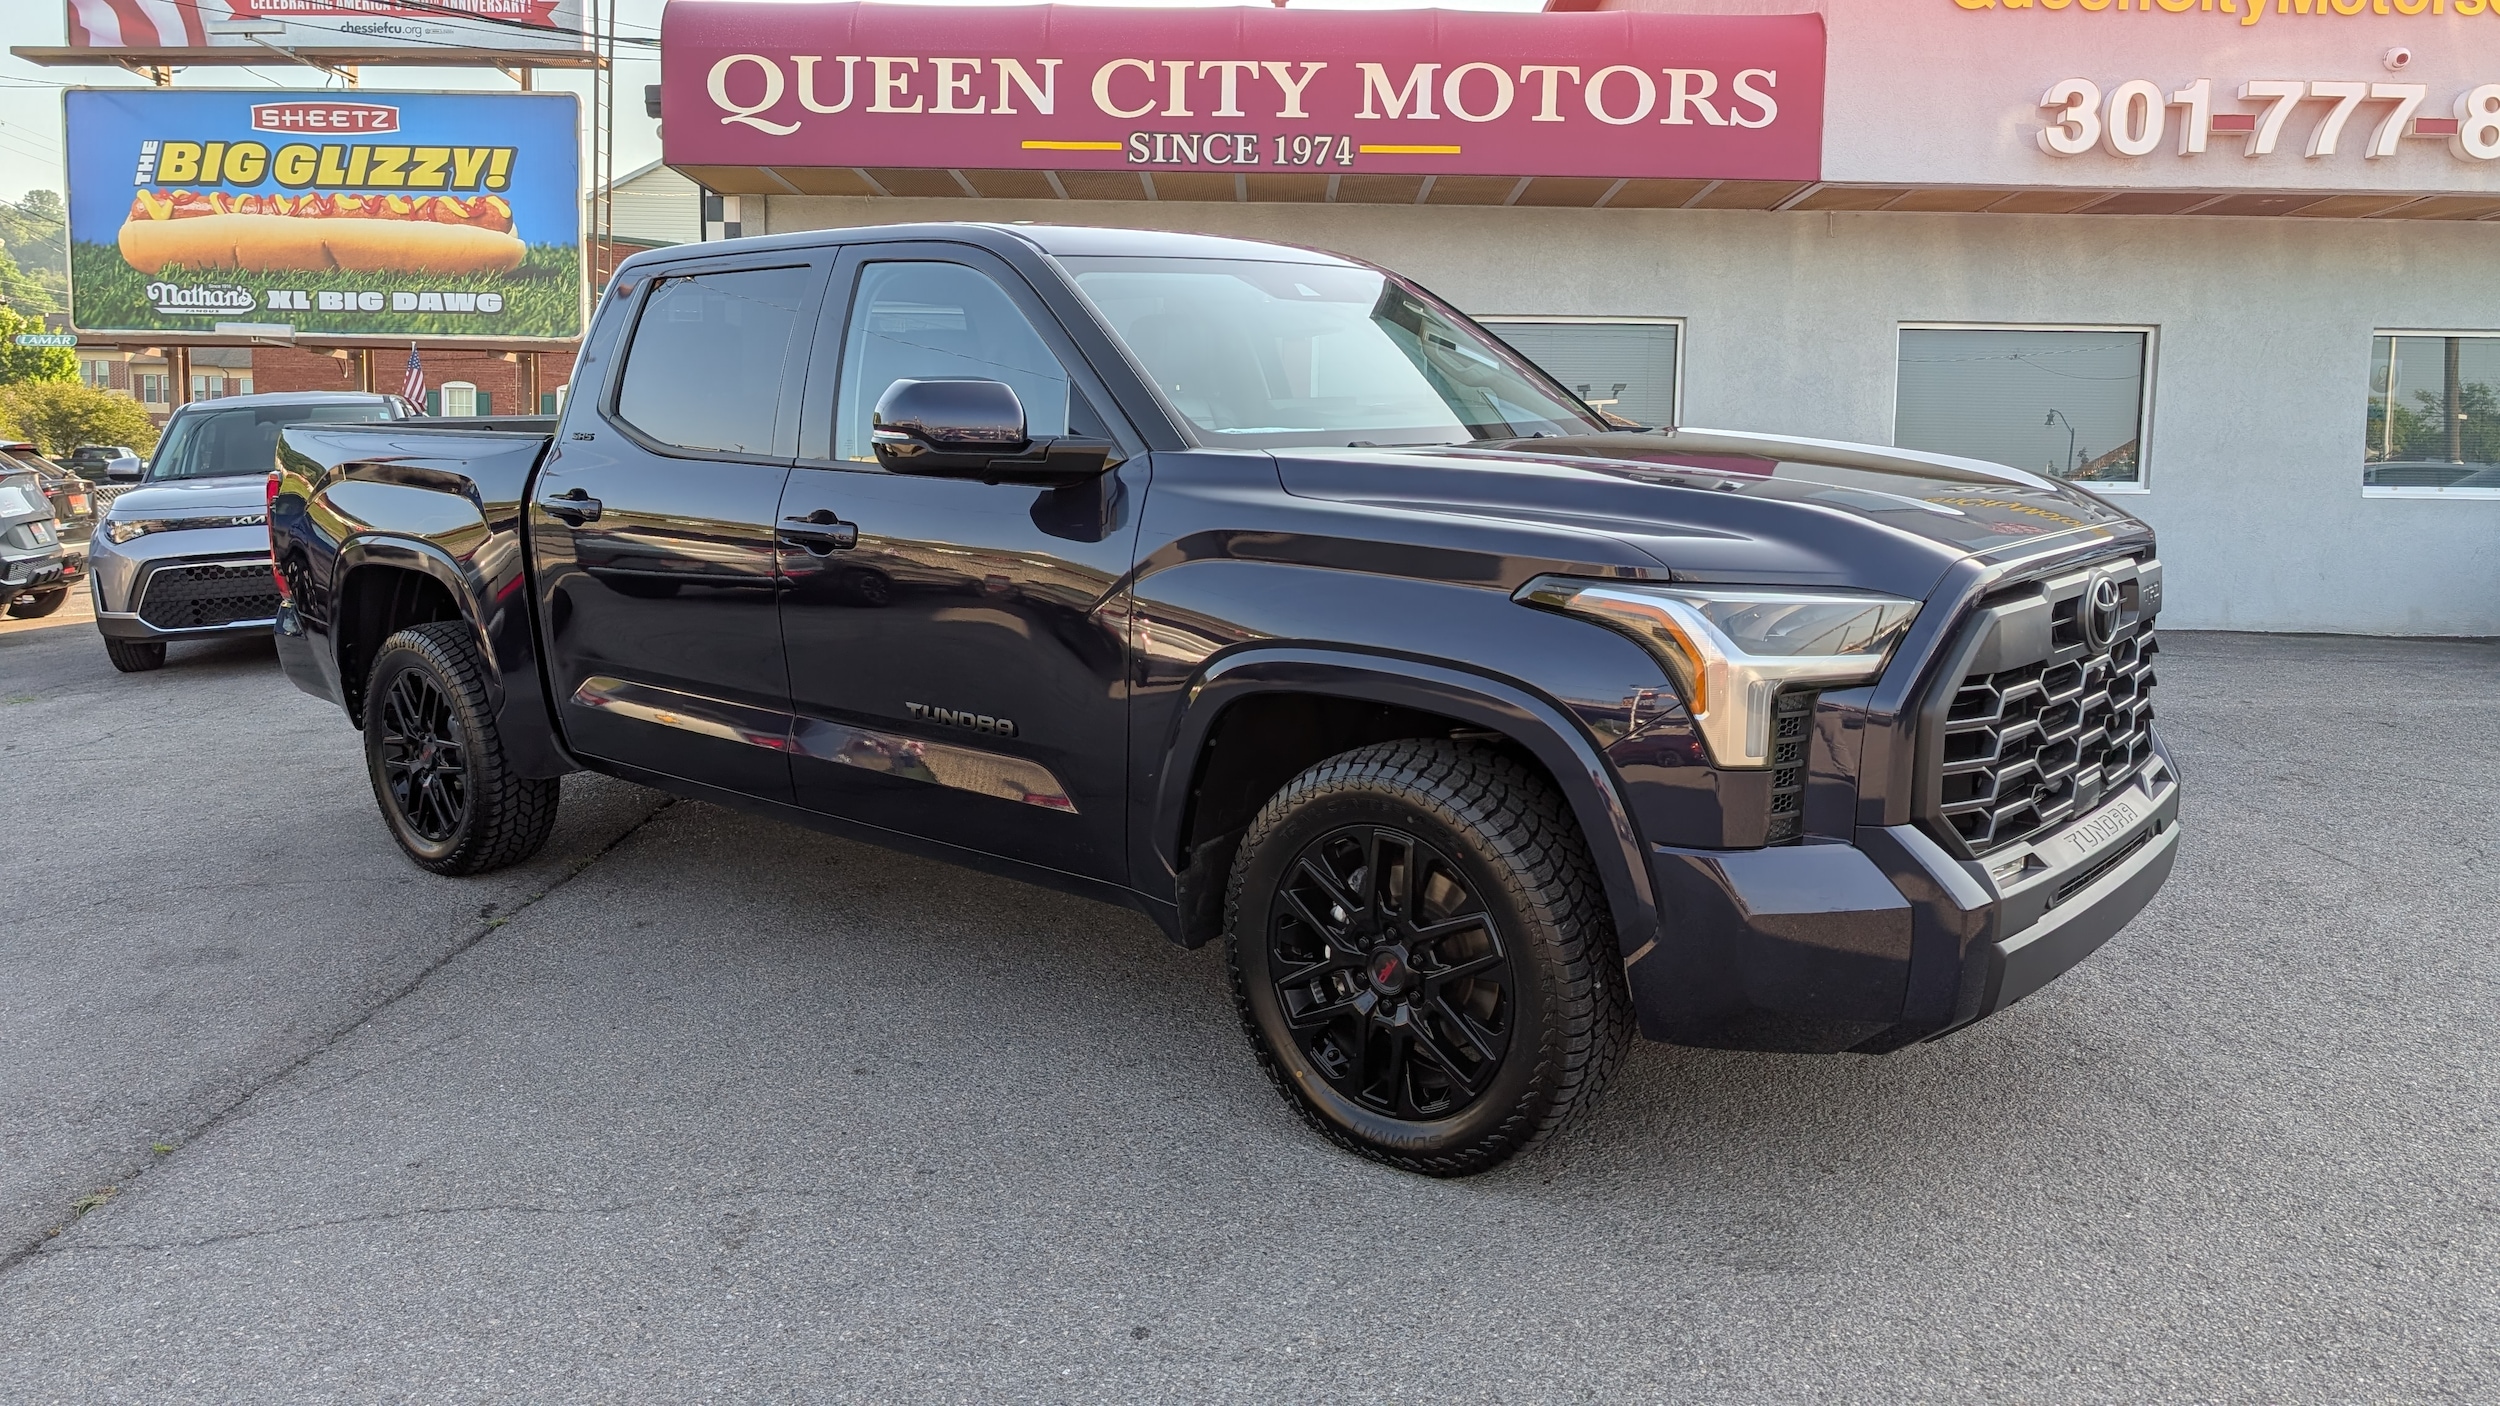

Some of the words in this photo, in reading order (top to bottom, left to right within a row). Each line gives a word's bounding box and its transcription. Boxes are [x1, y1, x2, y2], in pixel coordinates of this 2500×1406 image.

[336, 0, 402, 12] AMERICAS
[340, 21, 422, 37] chessiefcu.org
[706, 53, 1063, 136] QUEEN
[1091, 58, 1328, 119] CITY
[1354, 61, 1779, 130] MOTORS
[261, 109, 389, 129] SHEETZ
[134, 139, 159, 186] THE
[1128, 132, 1259, 164] SINCE
[1273, 135, 1354, 166] 1974
[156, 141, 270, 187] BIG
[273, 143, 514, 191] GLIZZY!
[147, 282, 255, 308] Nathan's
[267, 290, 311, 310] XL
[318, 291, 384, 311] BIG
[392, 292, 502, 313] DAWG
[20, 336, 72, 345] LAMAR
[904, 701, 1019, 738] TUNDRA
[2064, 802, 2139, 853] TUNDRA
